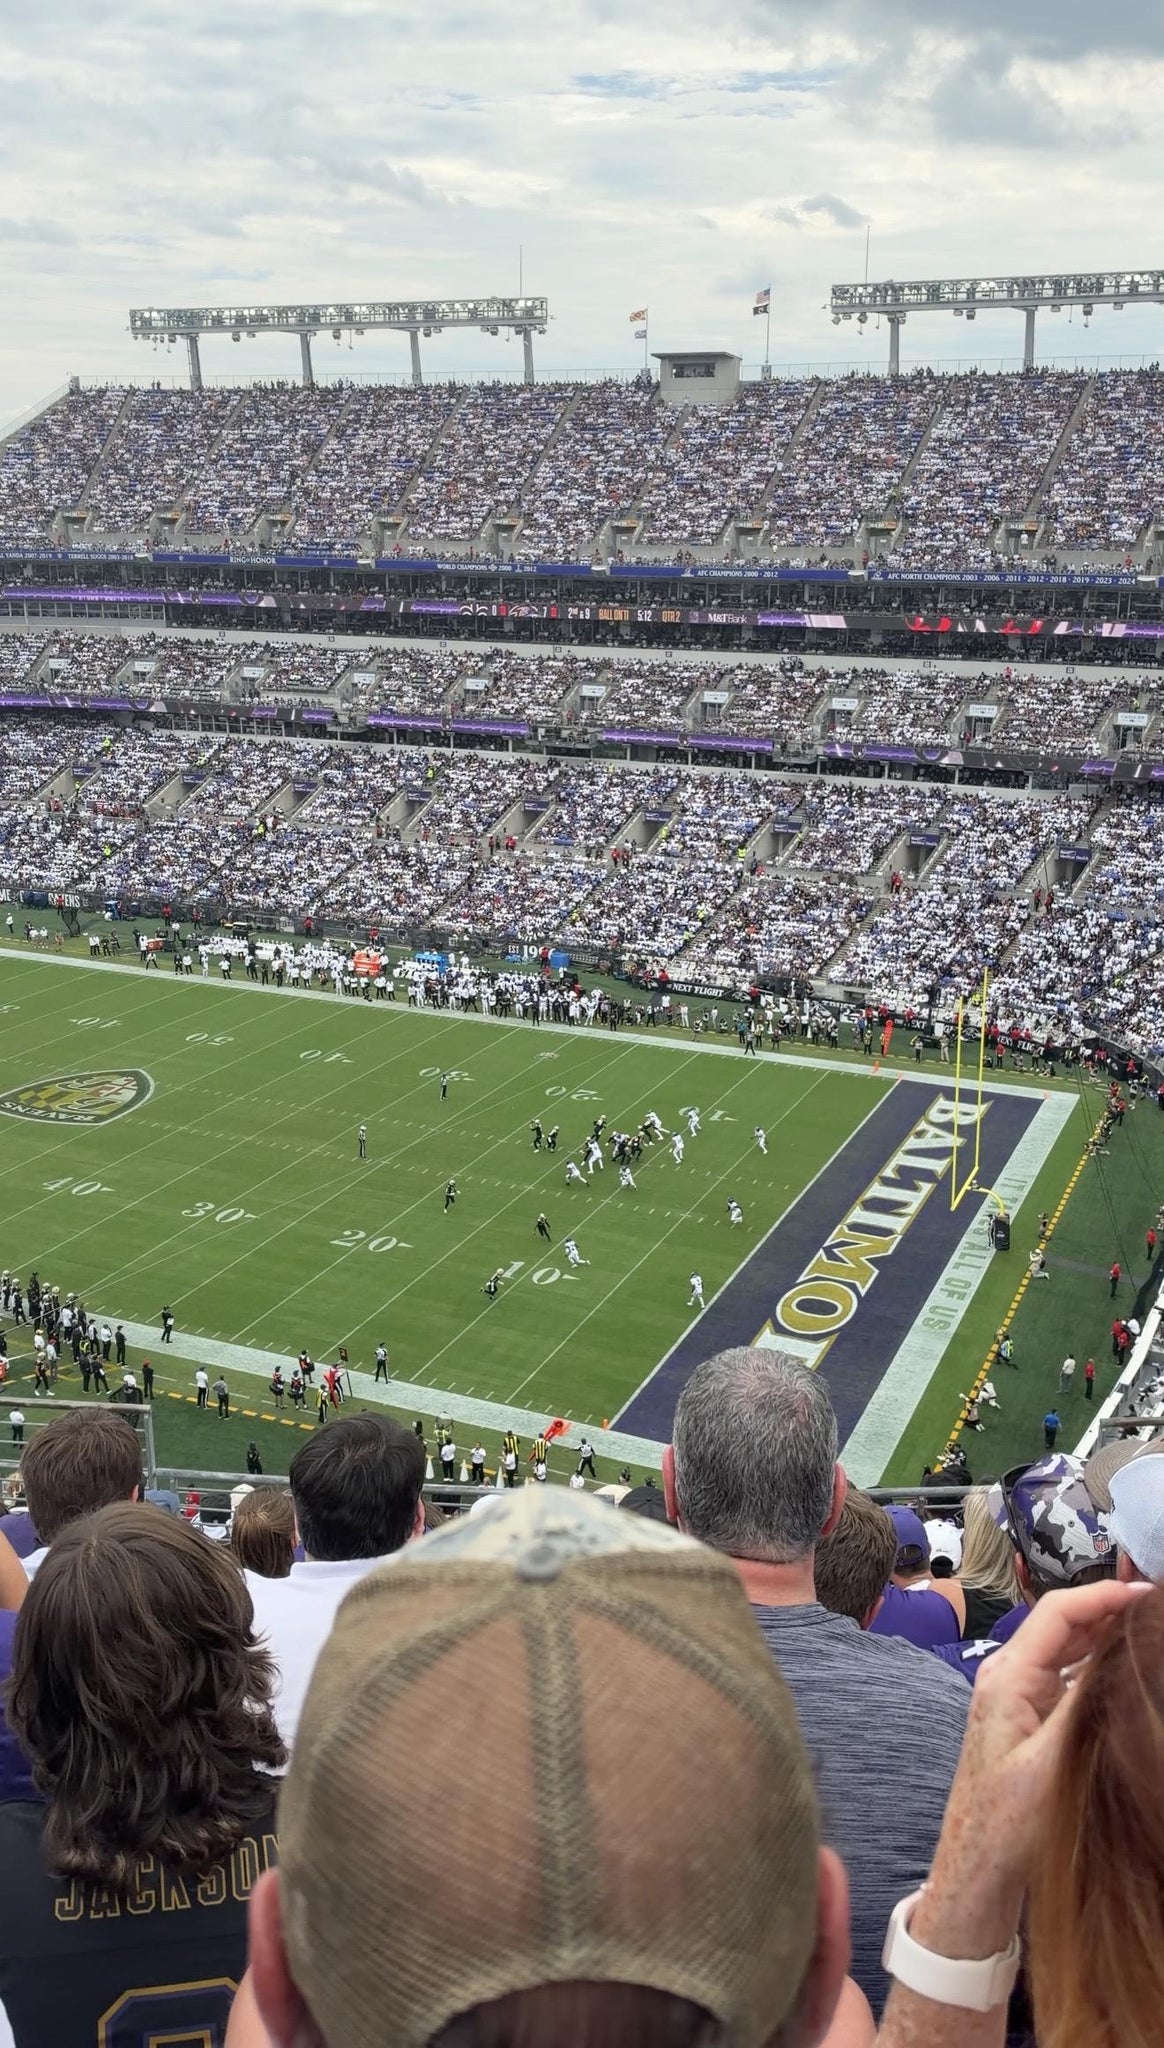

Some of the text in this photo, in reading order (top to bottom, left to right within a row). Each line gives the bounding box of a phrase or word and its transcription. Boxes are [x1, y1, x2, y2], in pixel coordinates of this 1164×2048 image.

[983, 574, 1000, 582] 2006
[1027, 575, 1044, 583] 2012
[1072, 576, 1090, 584] 2019
[1118, 577, 1136, 585] 2024
[637, 610, 652, 621] 5:12
[662, 610, 675, 622] QTR
[672, 983, 724, 997] NEXT FLIGHT
[1, 1101, 95, 1121] RAVENS
[41, 1176, 102, 1196] 40
[181, 1201, 245, 1223] 30
[330, 1229, 398, 1252] 20
[952, 1241, 988, 1270] ALL
[501, 1260, 562, 1285] 10
[940, 1277, 972, 1301] OF
[922, 1305, 959, 1330] US
